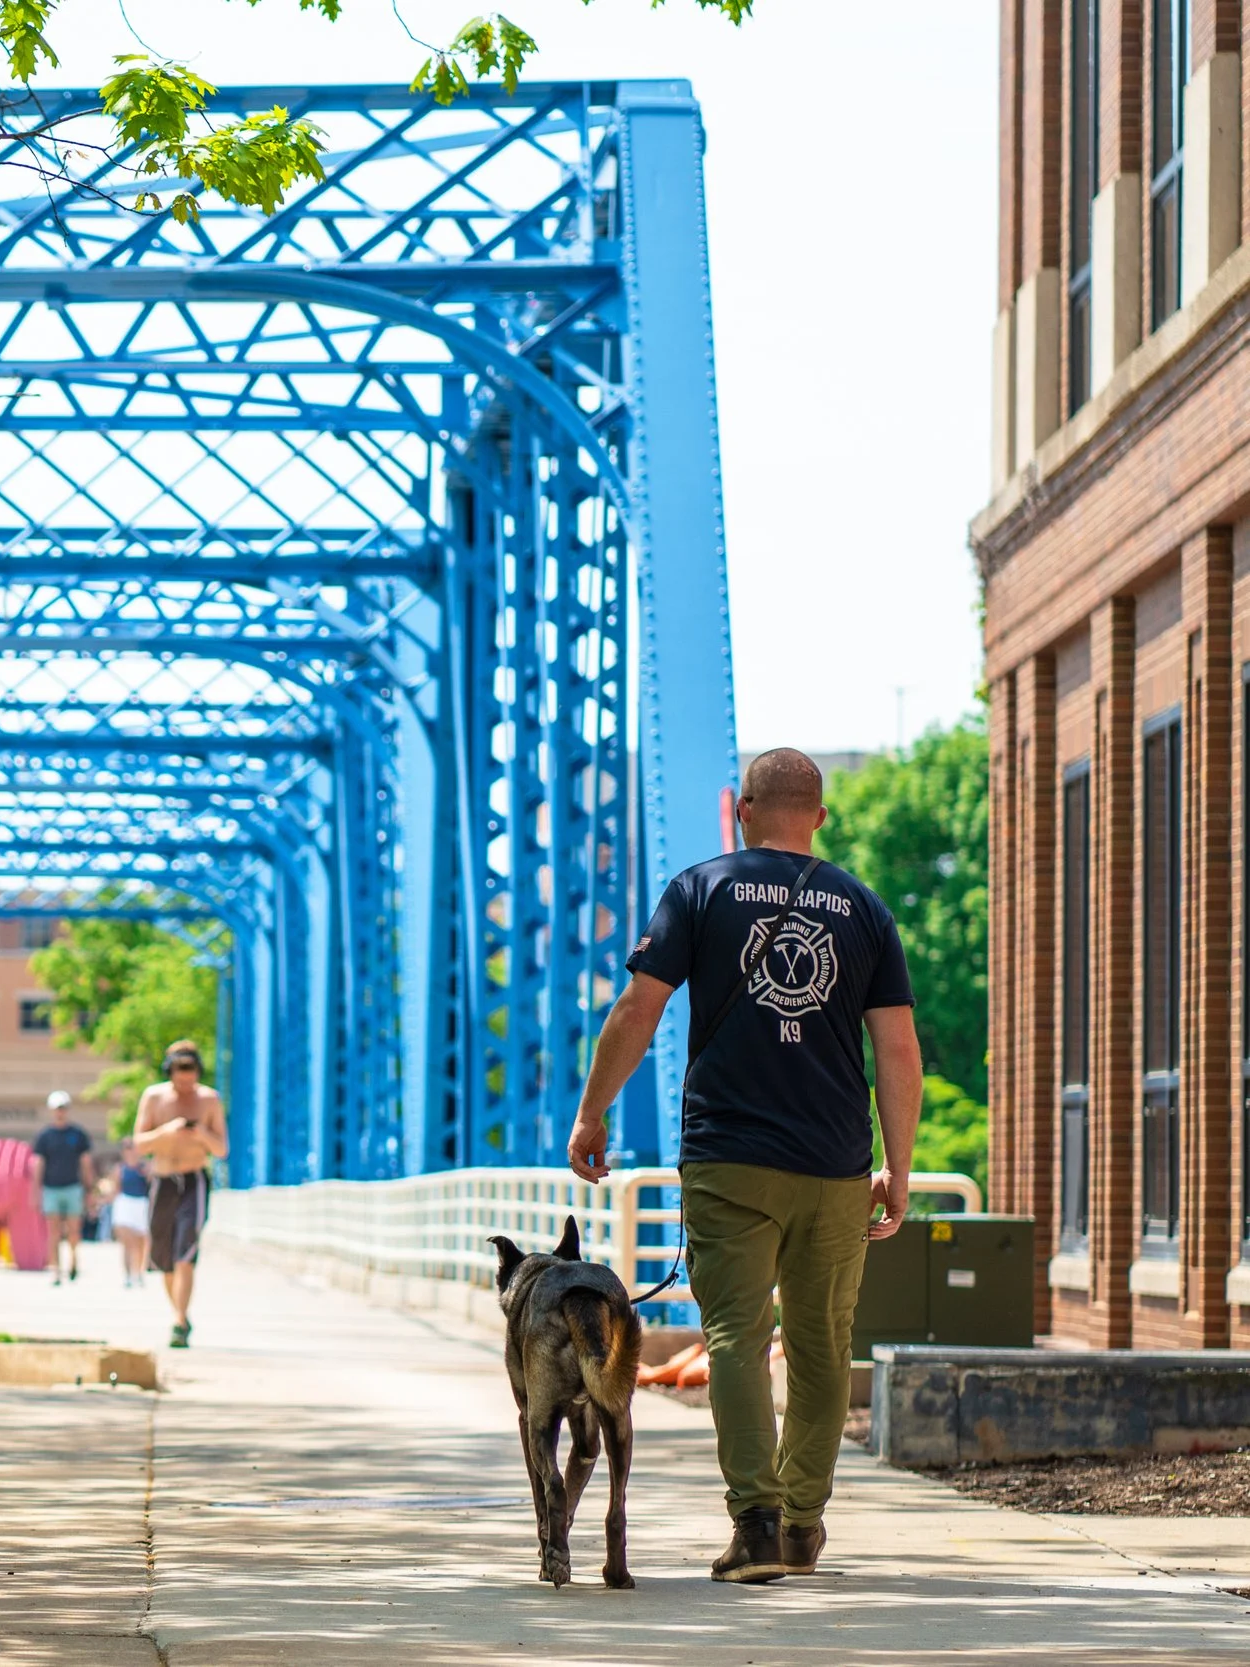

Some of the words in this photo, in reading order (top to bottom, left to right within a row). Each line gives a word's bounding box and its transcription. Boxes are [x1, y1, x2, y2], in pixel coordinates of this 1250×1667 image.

[734, 882, 789, 906] GRAND
[793, 889, 851, 917] RAPIDS
[771, 921, 811, 937] AINING
[816, 947, 830, 990] BOARDING
[768, 991, 814, 1007] OBEDIENCE
[780, 1020, 801, 1043] K9
